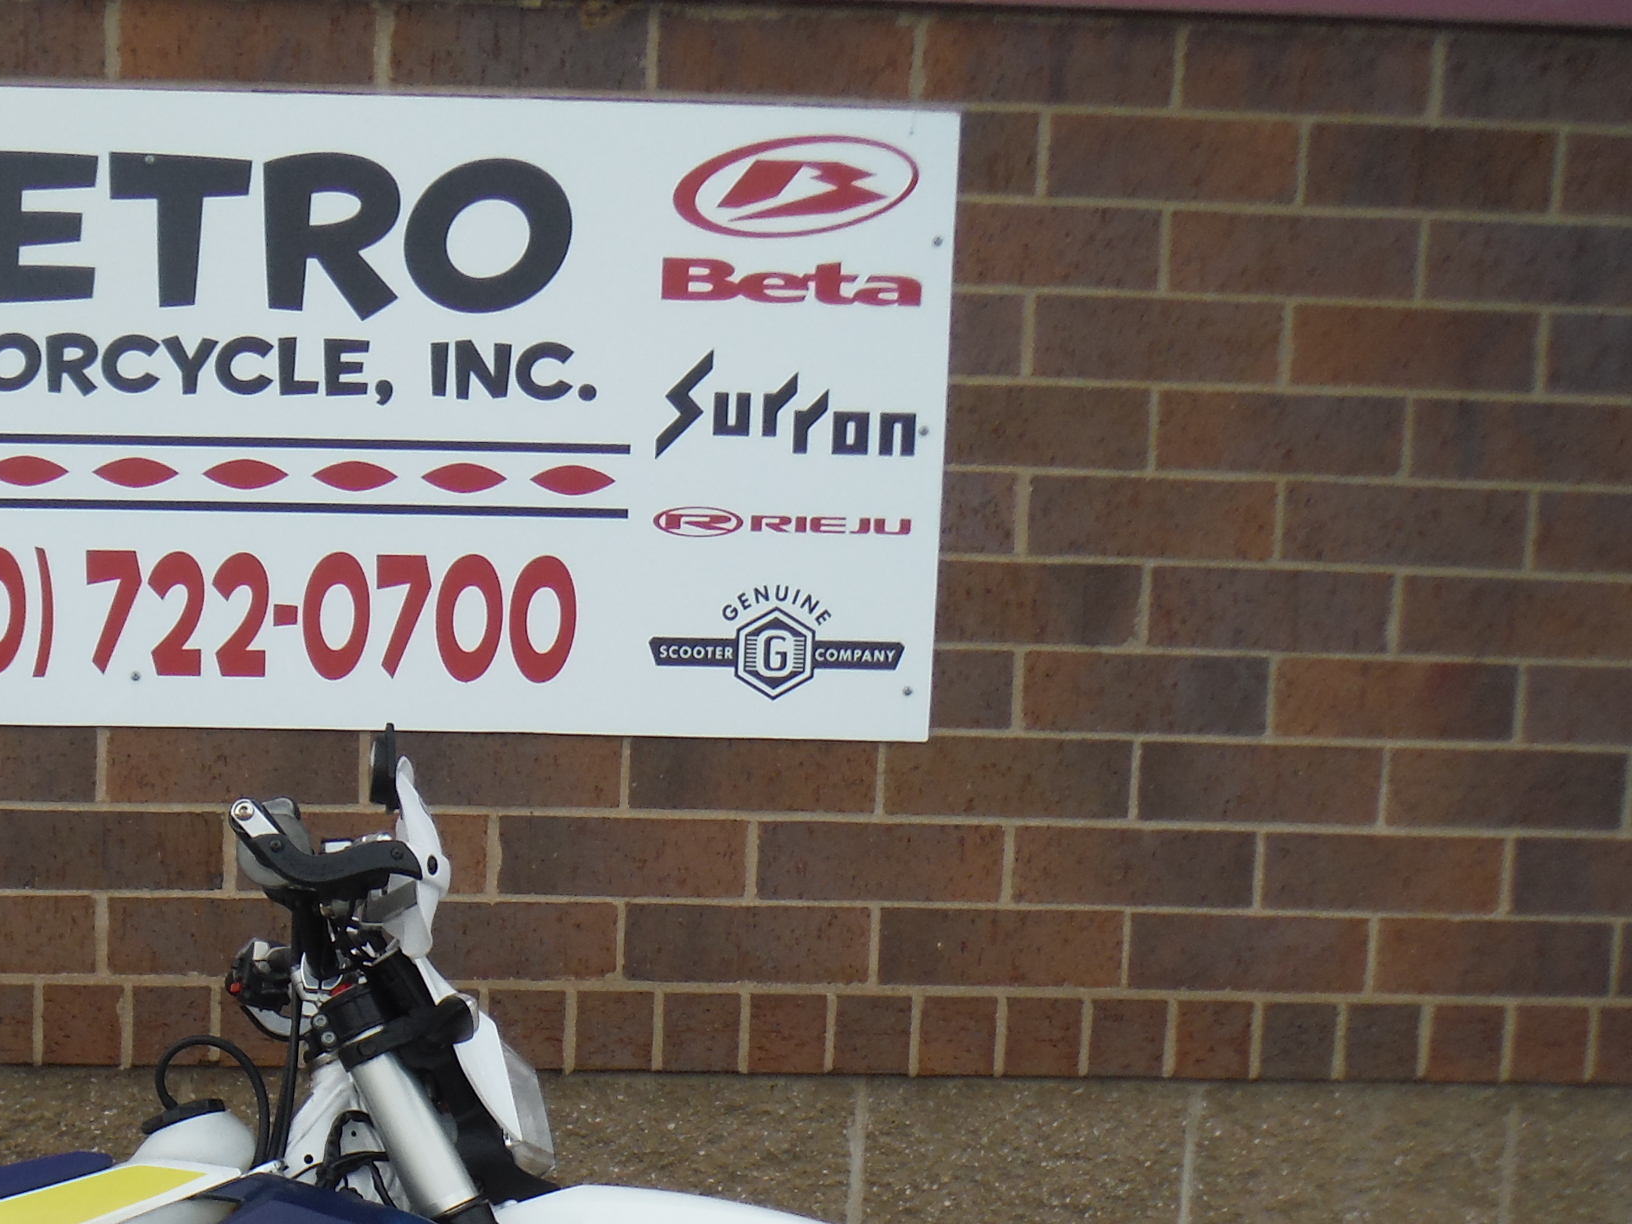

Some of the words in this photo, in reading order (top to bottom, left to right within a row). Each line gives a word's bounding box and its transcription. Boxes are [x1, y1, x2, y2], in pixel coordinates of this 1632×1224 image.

[661, 257, 922, 307] Beta
[430, 338, 598, 402] INC.
[655, 347, 917, 460] Surron
[750, 515, 912, 535] RIEJU
[85, 549, 577, 684] 722-0700
[721, 584, 832, 626] GENUINE
[659, 645, 734, 660] SCOOTER
[814, 648, 896, 663] COMPANY
[762, 635, 788, 672] G
